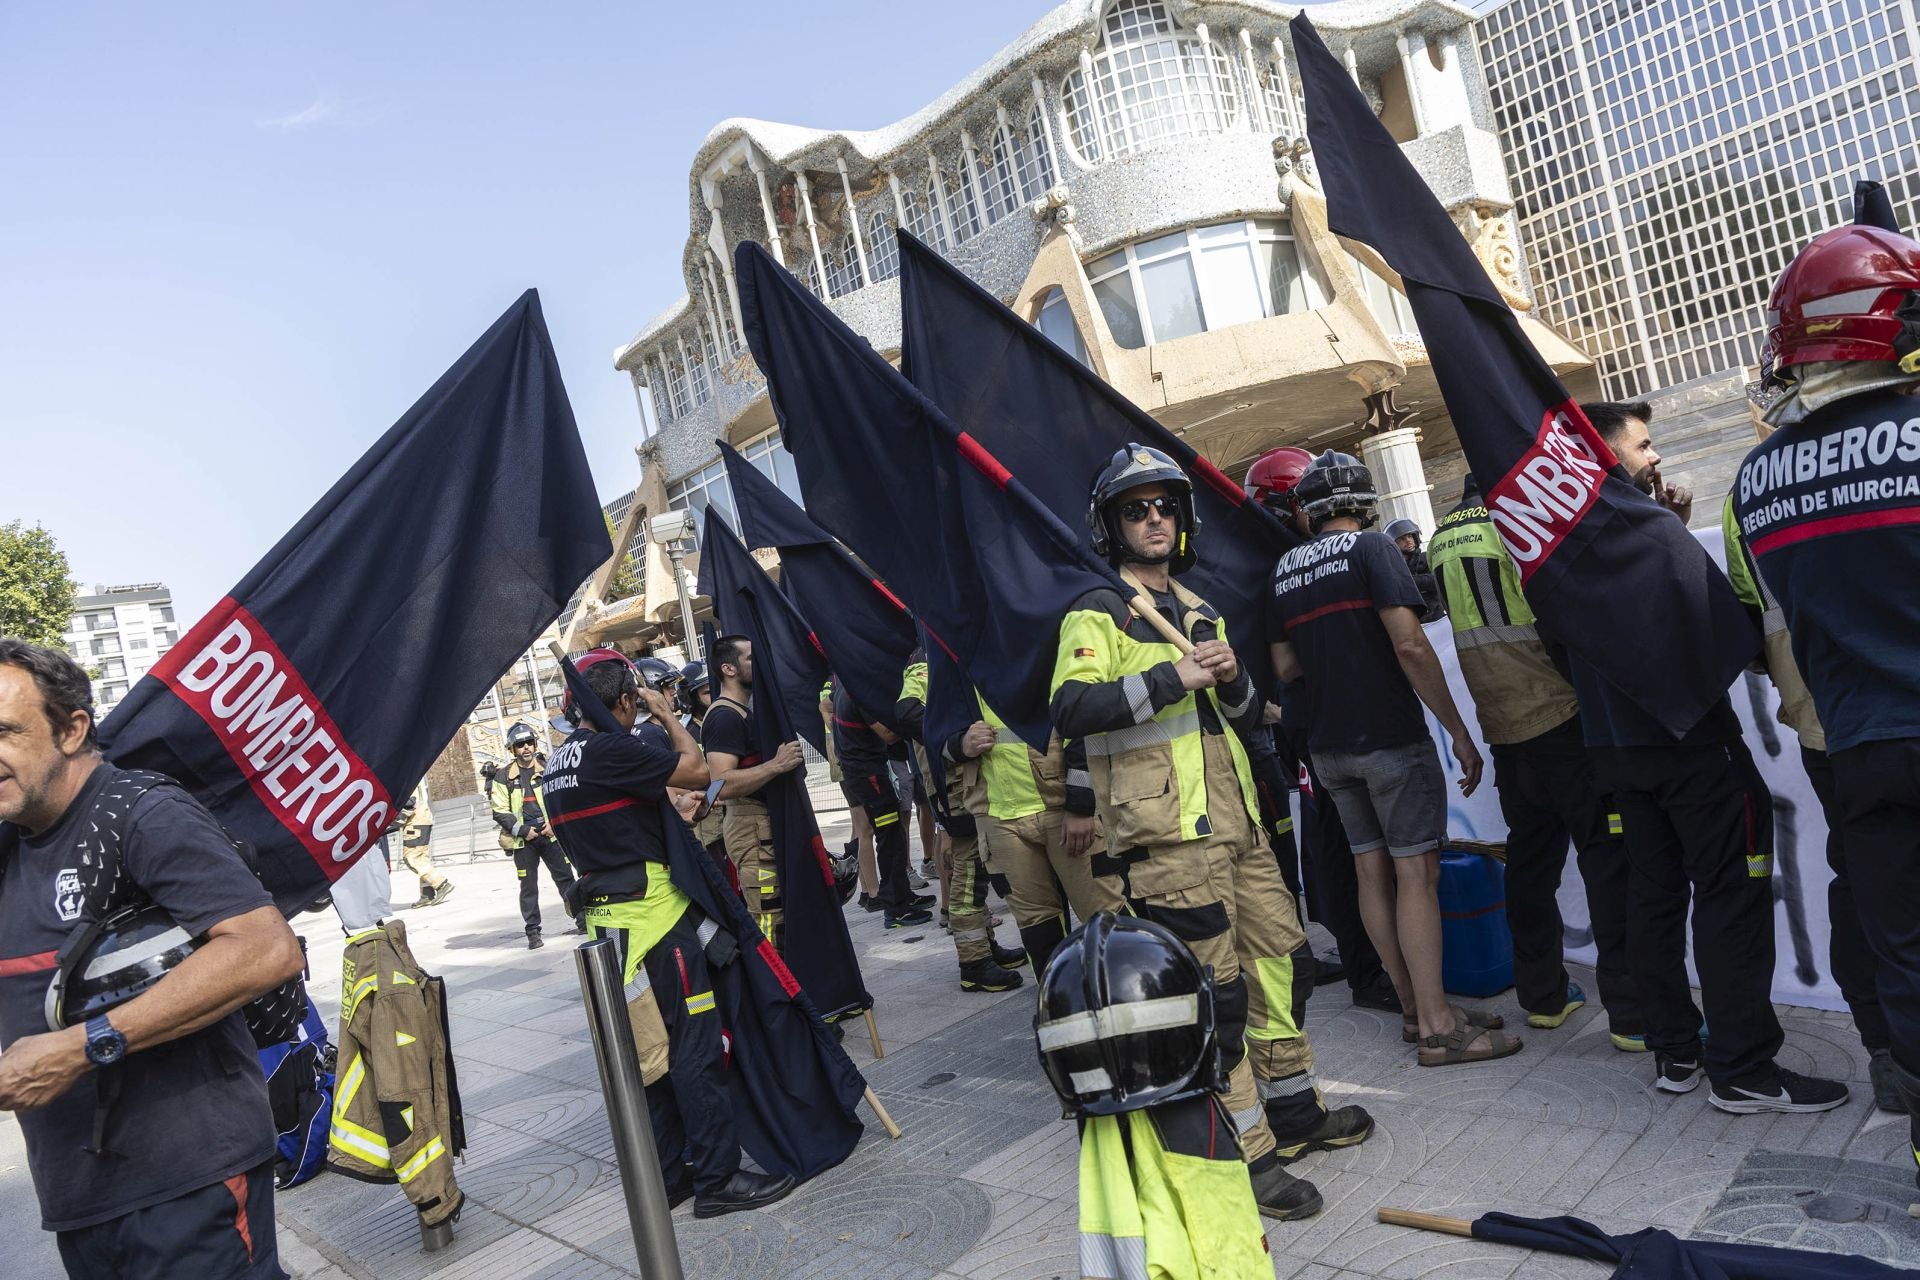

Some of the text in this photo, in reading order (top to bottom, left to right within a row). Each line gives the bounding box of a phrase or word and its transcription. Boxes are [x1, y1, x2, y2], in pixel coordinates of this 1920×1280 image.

[1740, 417, 1920, 505] BOMBEROS
[1438, 506, 1488, 527] OMBEROS
[1742, 475, 1920, 535] REGIÓN DE MURCIA
[1275, 531, 1362, 577] BOMBEROS
[1314, 559, 1349, 581] MURCIA
[176, 618, 388, 862] BOMBEROS
